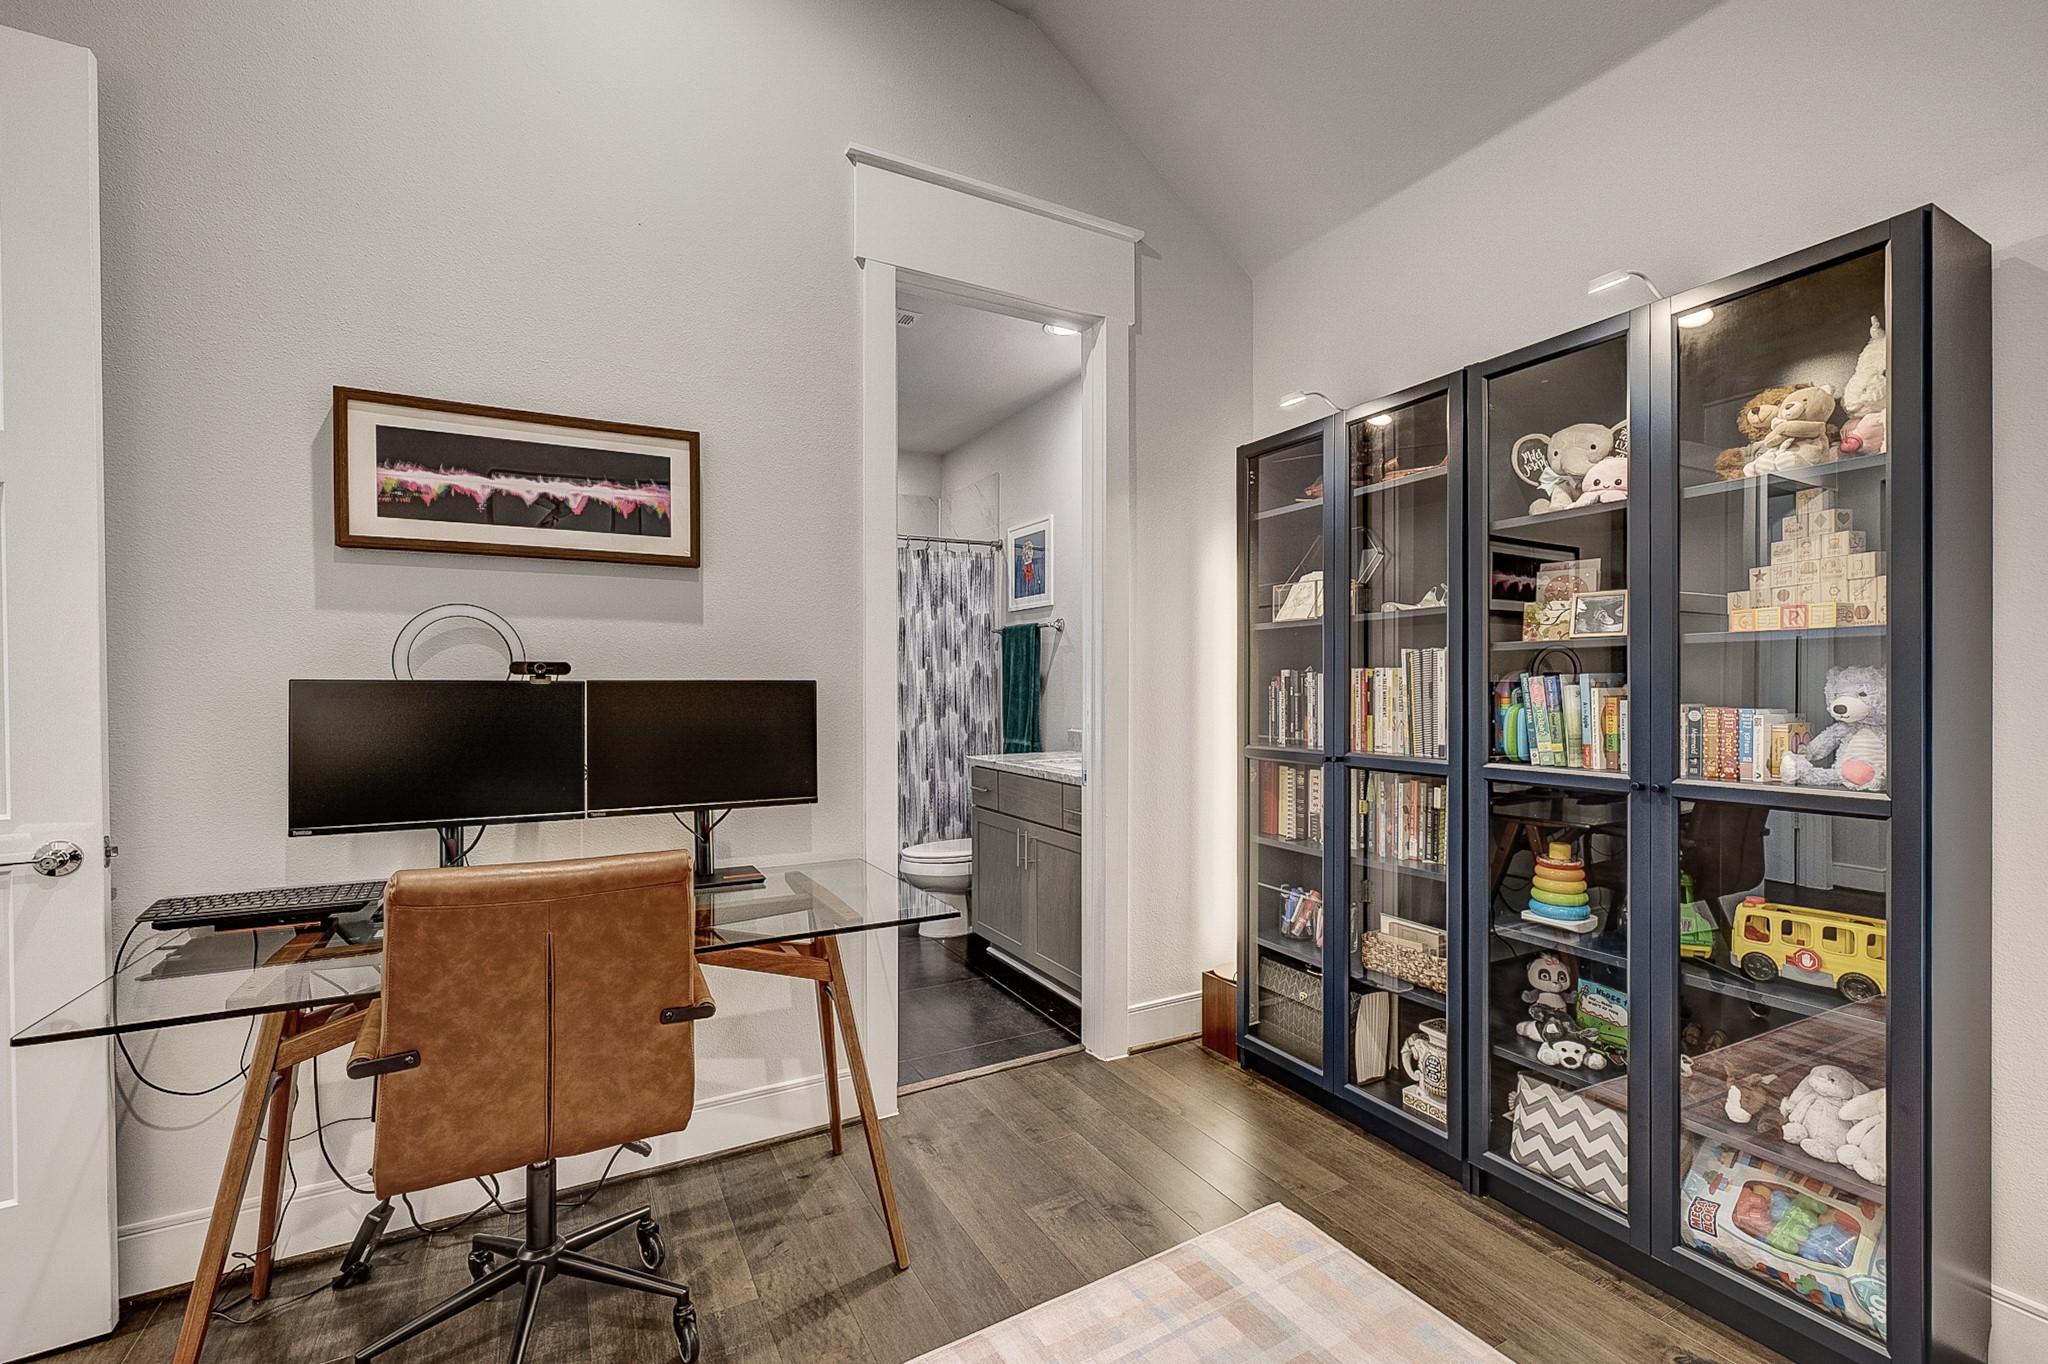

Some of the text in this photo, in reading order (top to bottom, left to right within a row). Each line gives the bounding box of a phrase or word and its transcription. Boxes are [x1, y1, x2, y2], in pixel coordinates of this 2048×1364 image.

[1789, 610, 1799, 625] R
[1690, 728, 1698, 755] Mermaid
[1726, 732, 1734, 756] Tractor
[1596, 988, 1621, 1003] Whose
[1690, 1198, 1704, 1229] MEGA
[1703, 1202, 1717, 1233] BLOKS
